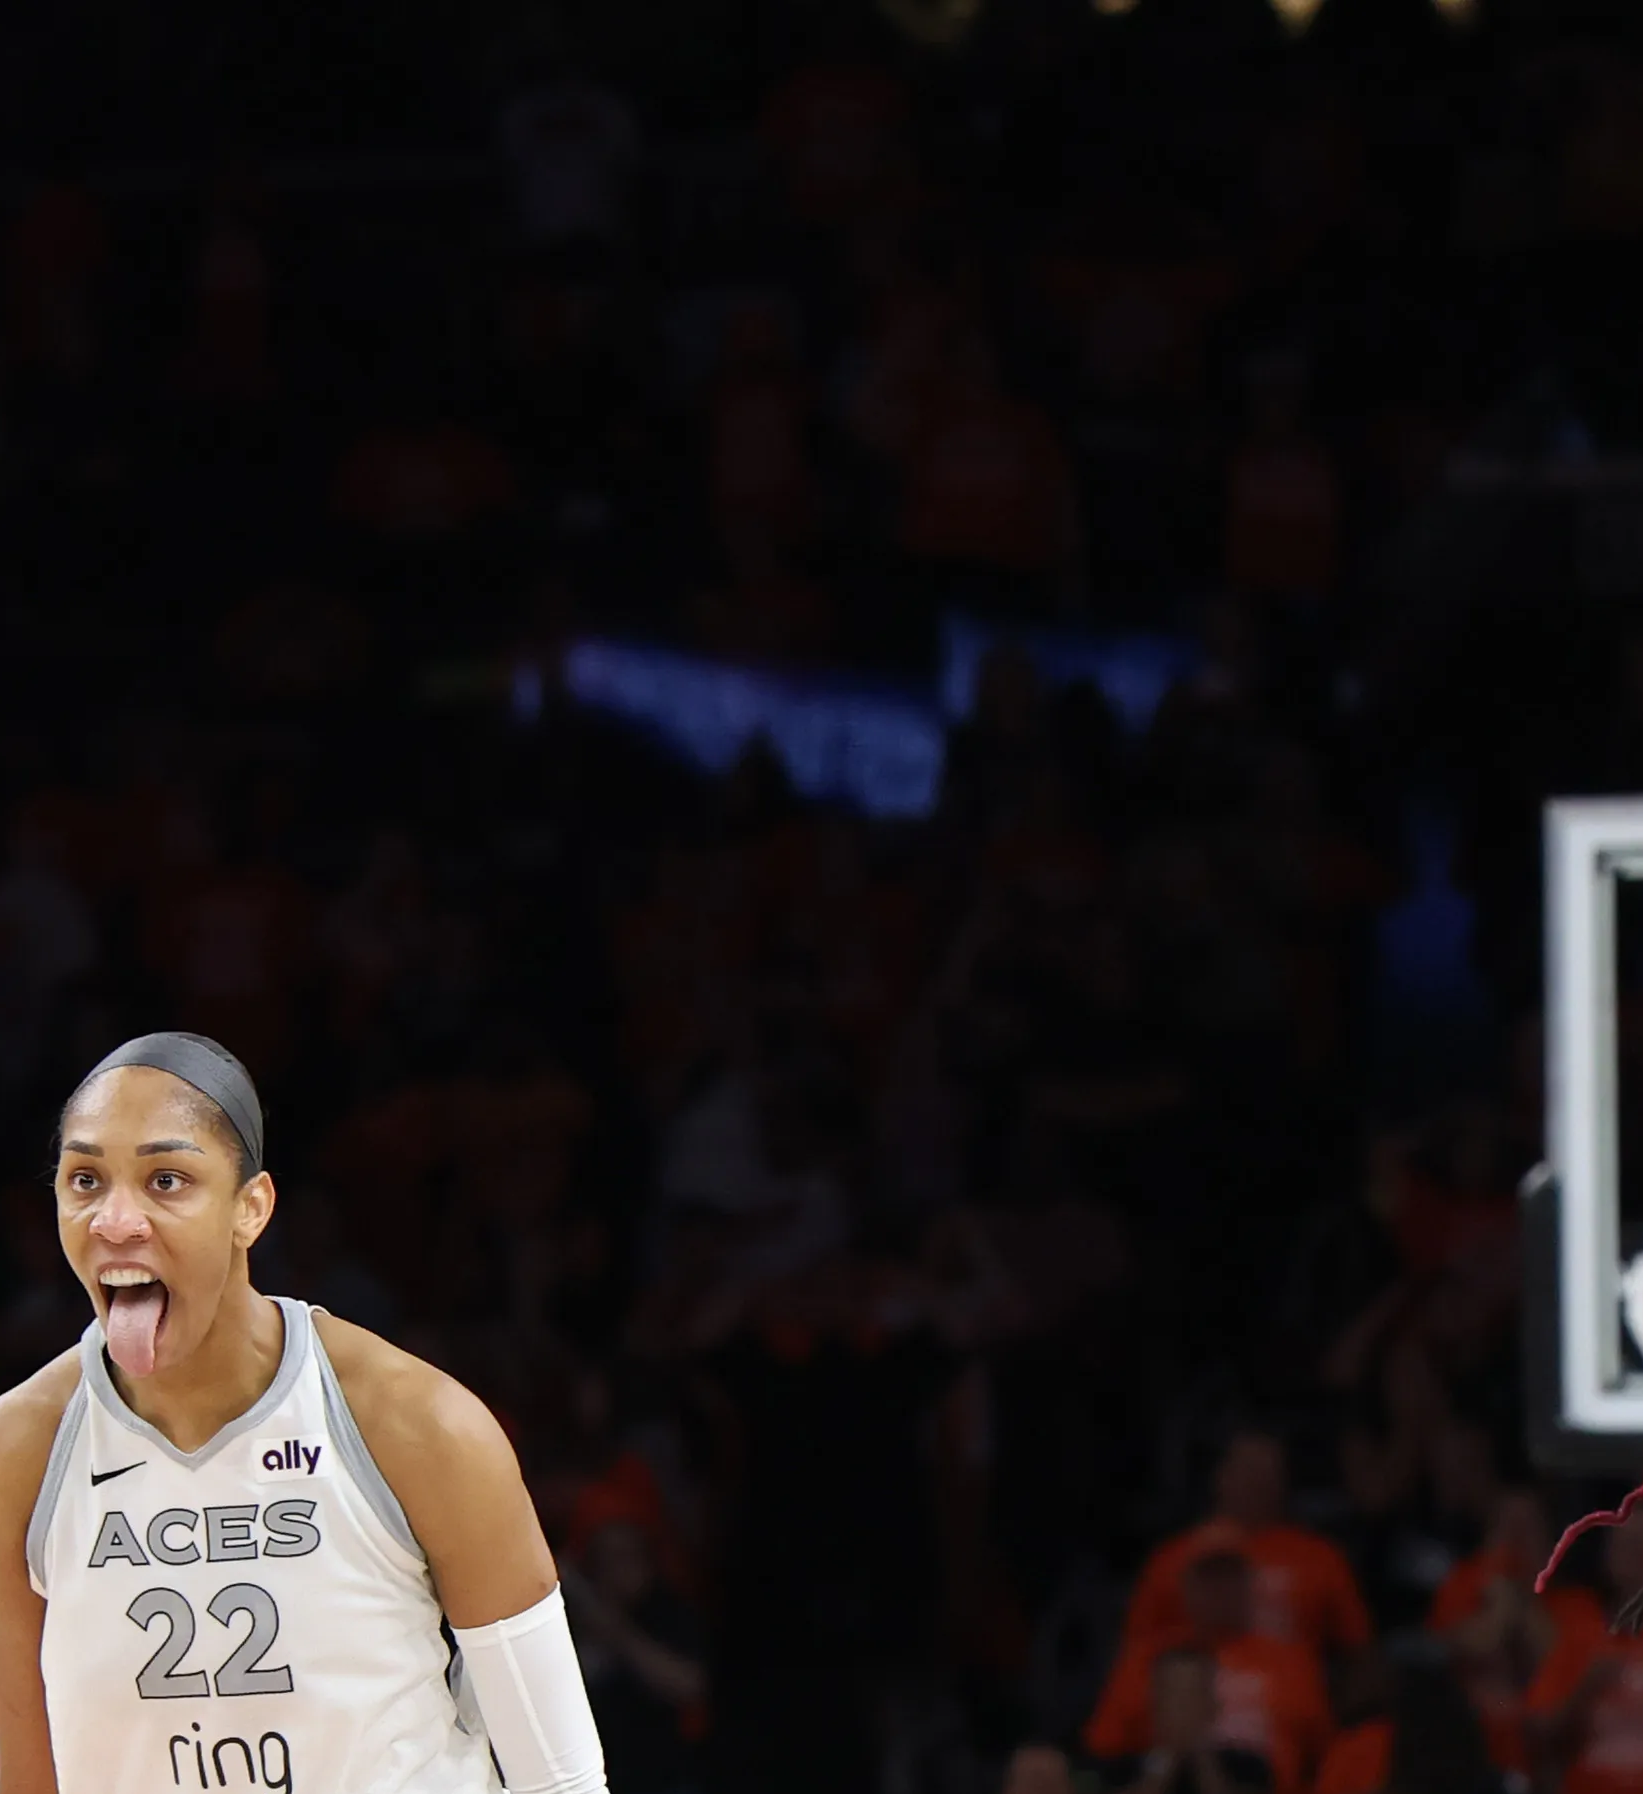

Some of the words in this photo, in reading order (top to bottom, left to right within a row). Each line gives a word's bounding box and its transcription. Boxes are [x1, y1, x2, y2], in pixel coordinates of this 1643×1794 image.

[261, 1439, 322, 1475] ally
[88, 1500, 321, 1568] ACES
[125, 1582, 293, 1700] 22
